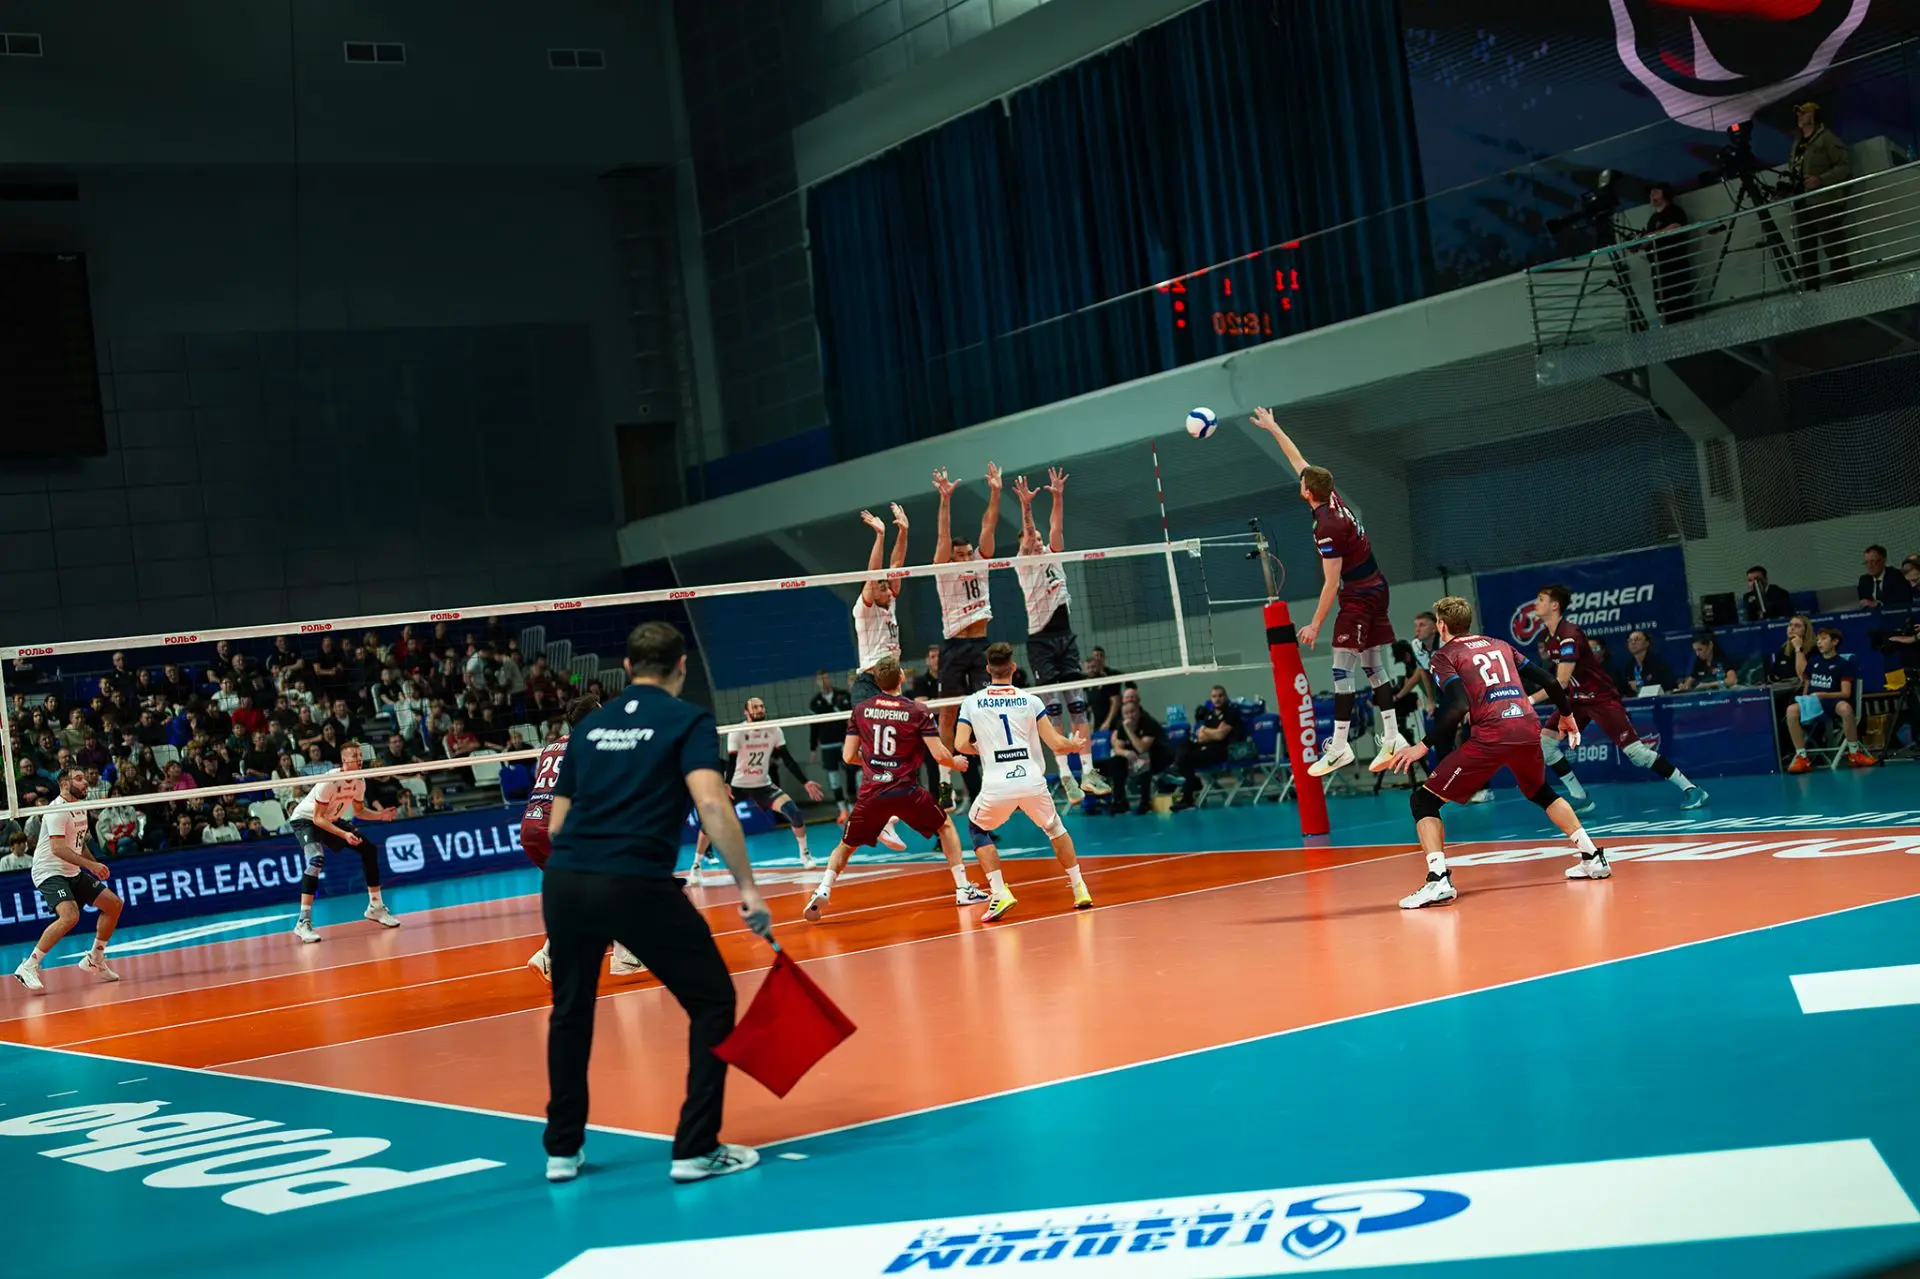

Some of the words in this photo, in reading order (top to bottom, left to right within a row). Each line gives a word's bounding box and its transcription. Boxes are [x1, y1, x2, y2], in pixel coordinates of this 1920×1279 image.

[780, 580, 806, 588] РОЛЬФ
[962, 579, 980, 600] 18
[669, 591, 696, 599] РОЛЬФ
[1567, 584, 1655, 610] ФАКЕЛ
[552, 601, 582, 609] РОЛЬФ
[431, 612, 460, 620] РОЛЬФ
[1566, 608, 1620, 625] ЯМАЛ
[300, 623, 332, 632] РОЛЬФ
[1584, 623, 1632, 637] ЙБОЛЬНЫЙ
[164, 635, 198, 644] РОЛЬФ
[18, 647, 53, 656] РОЛЬФ
[1473, 650, 1511, 687] 27
[977, 697, 1028, 708] КАЗАРИНОВ
[863, 707, 909, 722] СИДОРЕНКО
[1293, 673, 1319, 763] РОЛЬФ
[999, 714, 1013, 745] 1
[872, 724, 897, 756] 16
[748, 751, 764, 767] 22
[1578, 744, 1608, 762] ВФВ
[534, 756, 564, 788] 25
[432, 823, 524, 862] VOLLE
[1445, 834, 1920, 867] ОЛЬФ
[0, 889, 56, 924] LLE
[83, 854, 326, 913] UPERLEAGU
[57, 888, 67, 899] 15
[0, 1100, 507, 1215] РОЛЬФ
[882, 1223, 1268, 1275] ГАЗПРОМ
